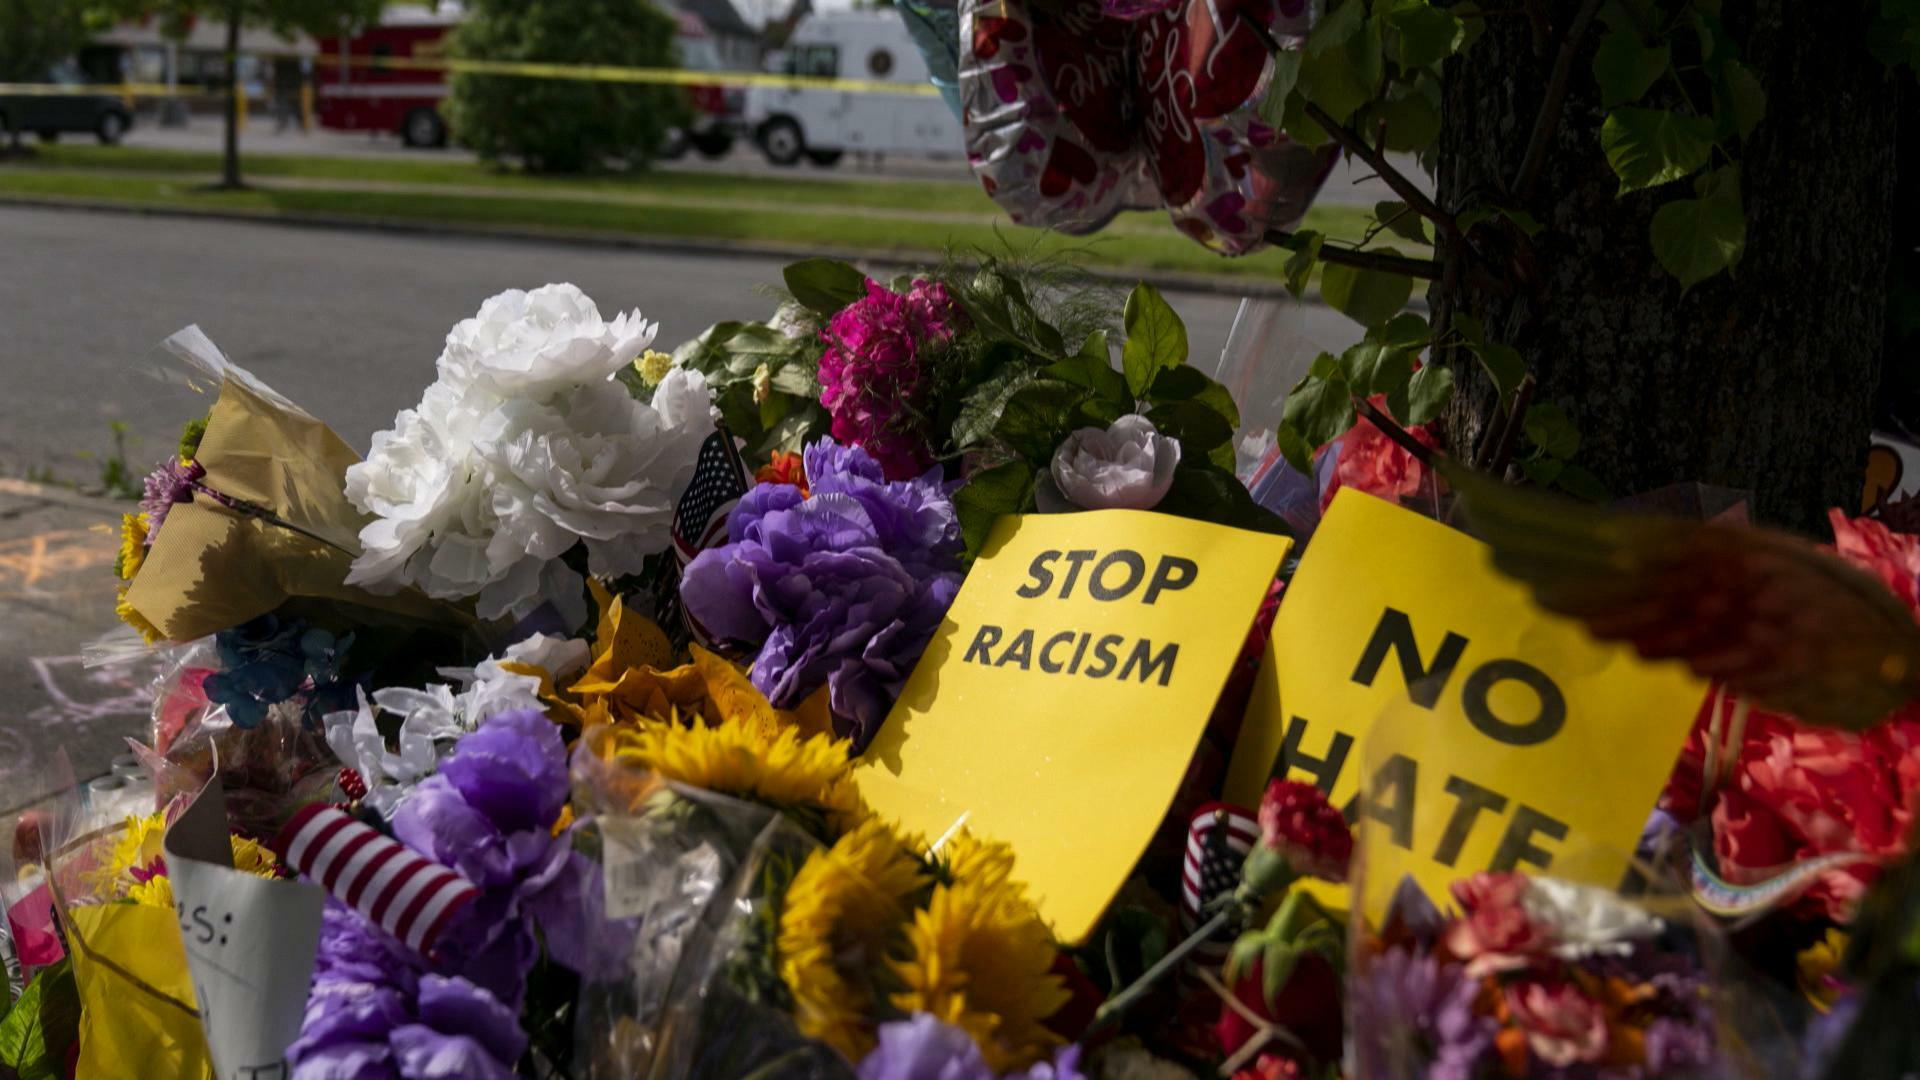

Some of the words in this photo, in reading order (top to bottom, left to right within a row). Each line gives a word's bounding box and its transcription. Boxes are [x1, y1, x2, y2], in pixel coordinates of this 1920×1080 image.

[1016, 549, 1198, 605] STOP
[963, 624, 1179, 686] RACISM
[1351, 606, 1567, 747] NO
